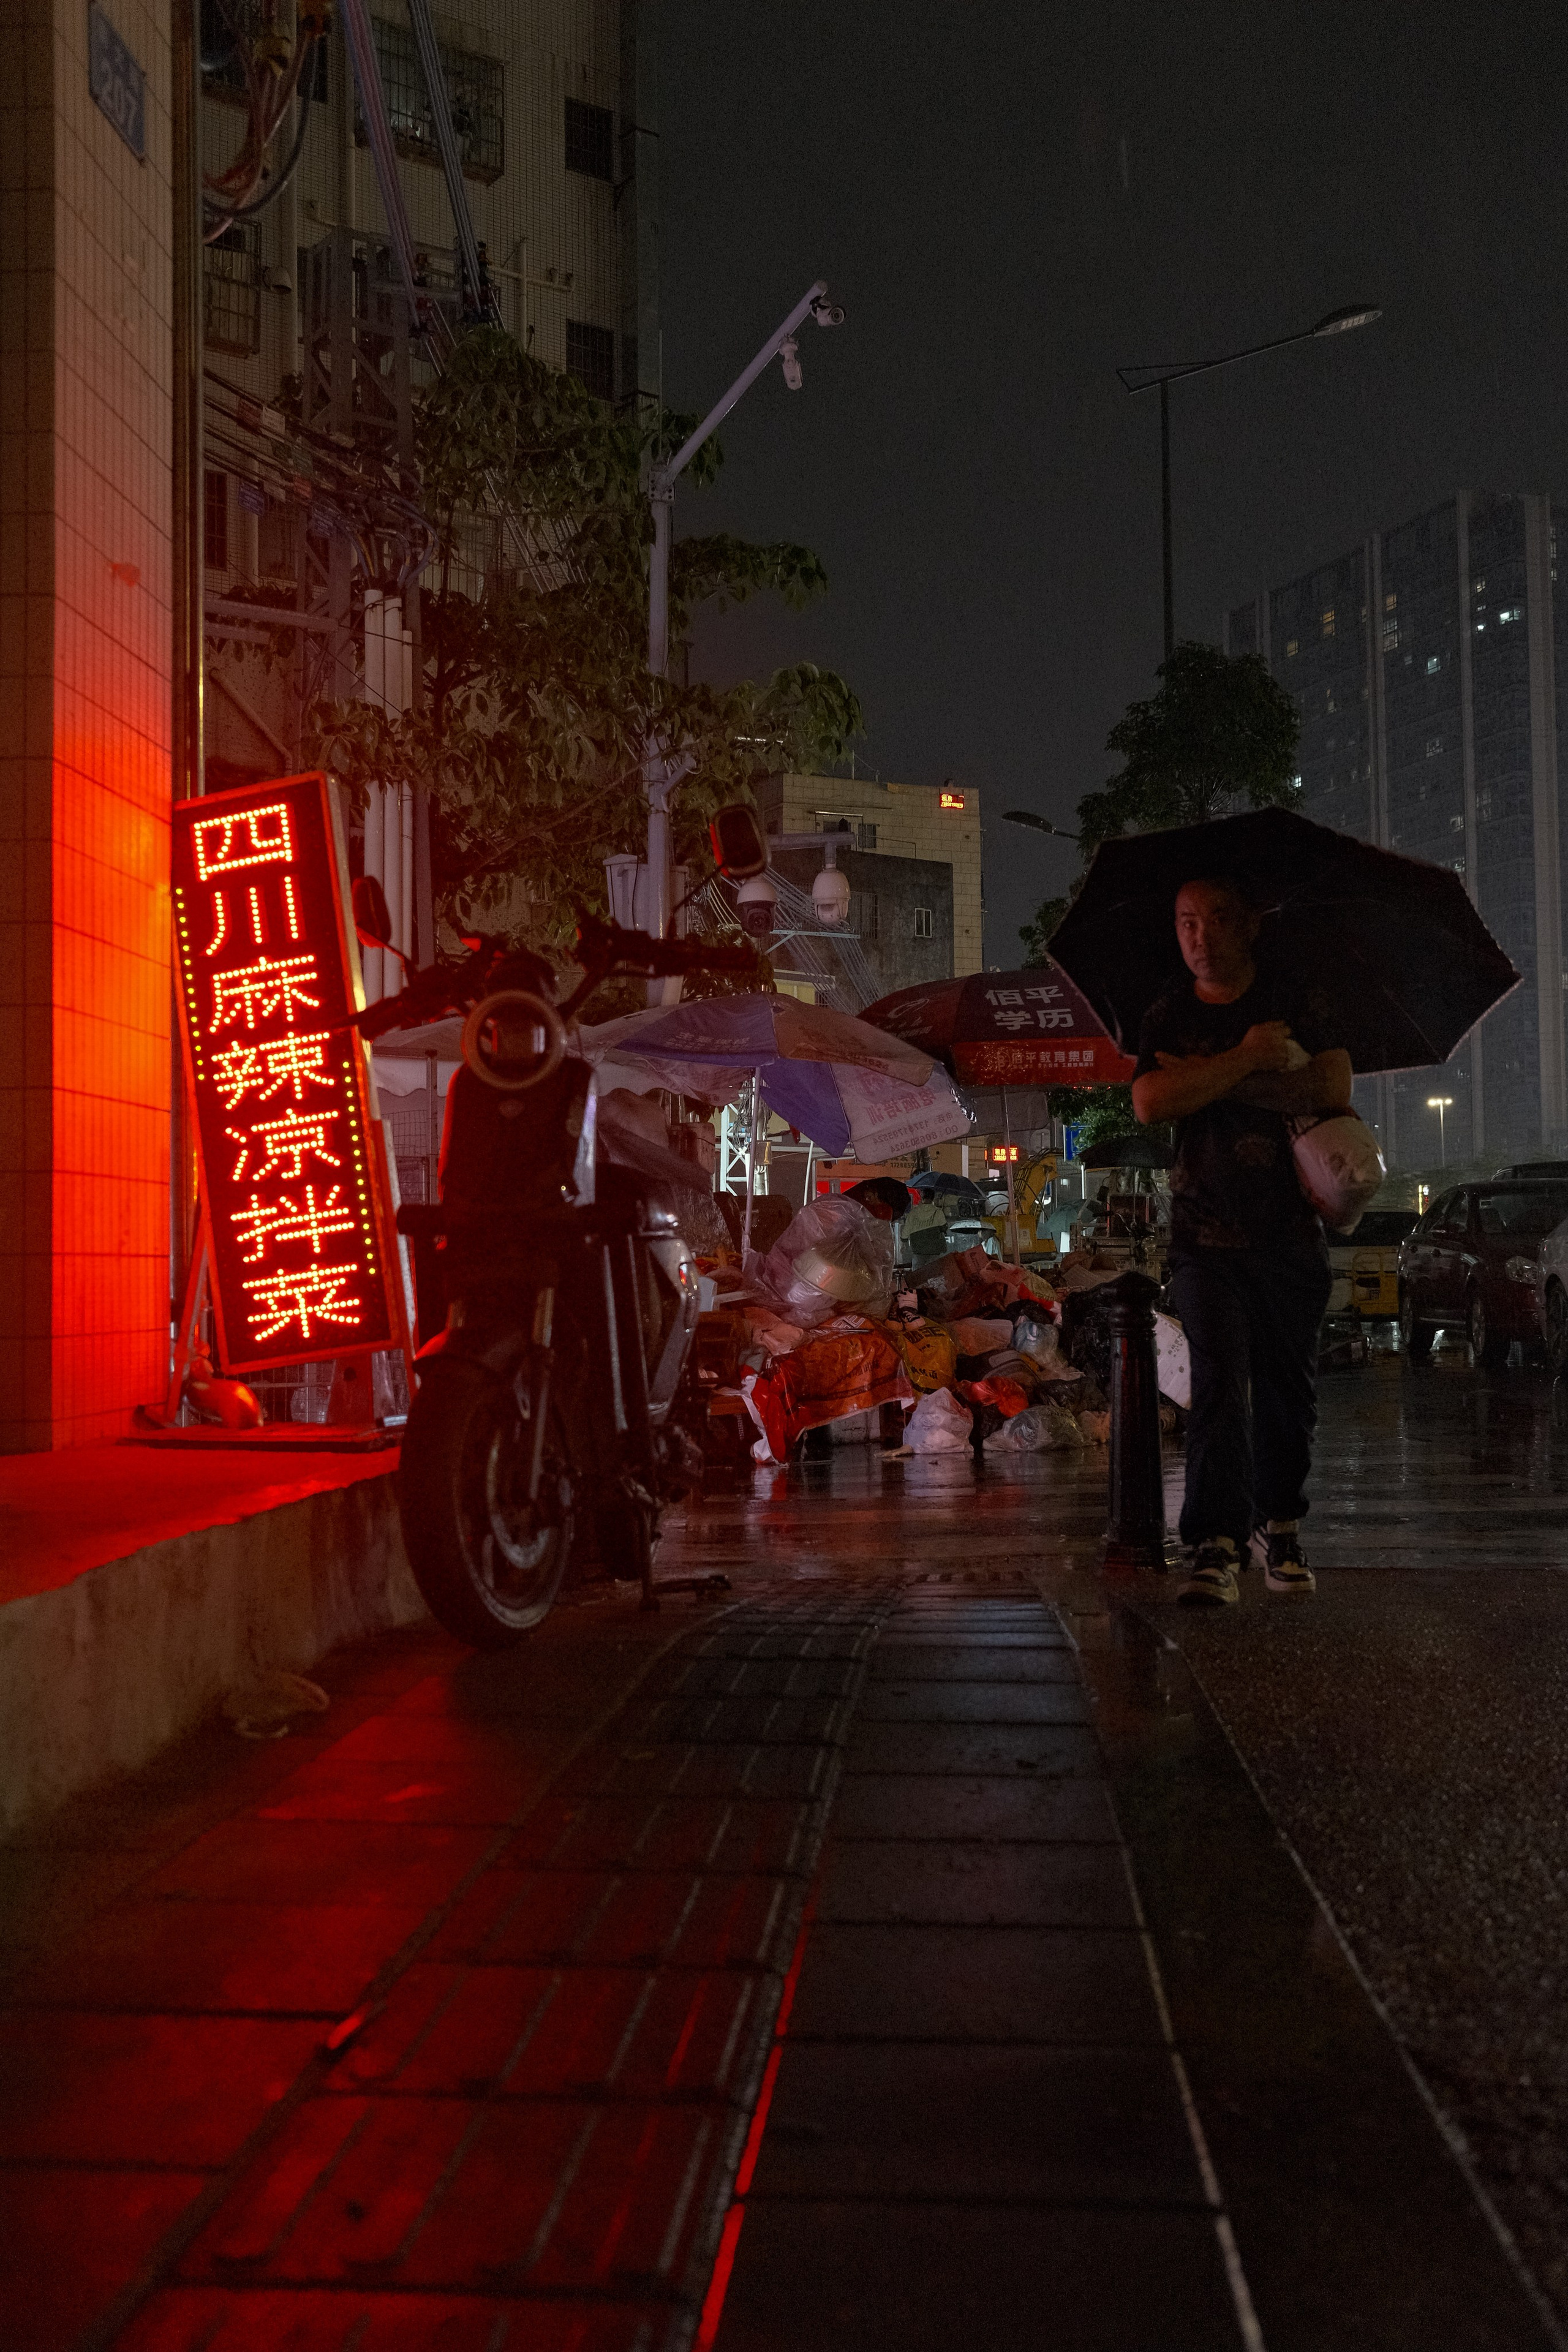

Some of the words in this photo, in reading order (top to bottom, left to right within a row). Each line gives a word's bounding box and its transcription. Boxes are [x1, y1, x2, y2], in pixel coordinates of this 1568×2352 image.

[984, 985, 1064, 1006] 佰平
[993, 1008, 1074, 1030] 学历
[1011, 1050, 1094, 1064] 佰平教育集团
[192, 802, 361, 1341] 四川麻辣凉拌菜
